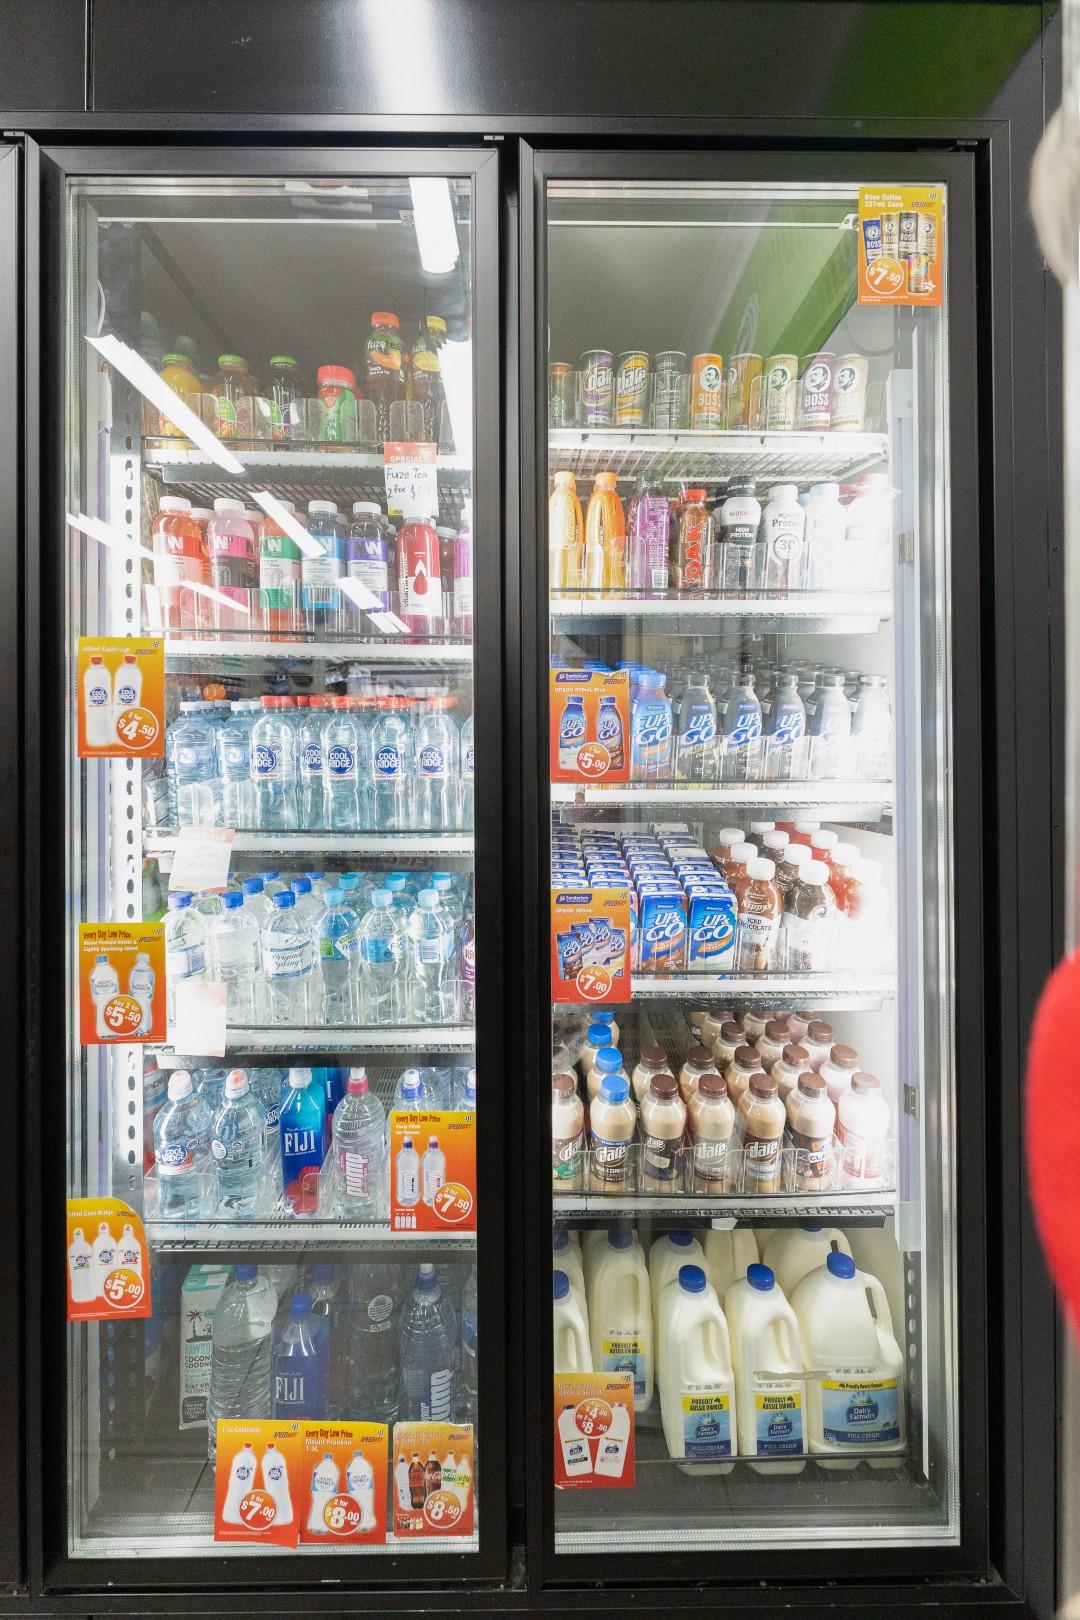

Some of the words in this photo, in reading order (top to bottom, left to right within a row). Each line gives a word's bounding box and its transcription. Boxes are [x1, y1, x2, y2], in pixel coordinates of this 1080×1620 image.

[588, 366, 612, 390] dar
[805, 394, 829, 406] BOSS
[386, 468, 410, 480] Fuze
[684, 514, 703, 578] OAK
[637, 724, 672, 744] GO
[680, 727, 716, 745] GO
[728, 726, 762, 745] GO
[328, 759, 351, 768] RIDGE
[378, 759, 399, 768] RIDGE
[421, 759, 442, 767] RIDGE
[703, 914, 730, 926] UP&
[84, 931, 97, 940] Every
[98, 930, 106, 940] Day
[108, 930, 117, 938] Low
[119, 930, 131, 938] Price
[646, 922, 684, 941] GO
[694, 924, 733, 941] GO
[106, 1006, 140, 1026] $5.50
[396, 1115, 408, 1124] Every
[409, 1114, 418, 1123] Day
[419, 1114, 428, 1122] Low
[284, 1130, 315, 1152] FIJI
[647, 1137, 664, 1148] dare
[750, 1142, 778, 1157] dare
[600, 1146, 626, 1162] dare
[697, 1142, 726, 1158] dare
[346, 1152, 369, 1198] pump
[436, 1193, 469, 1212] $7.50
[105, 1280, 141, 1300] $5.00
[276, 1377, 304, 1400] FIJI
[306, 1430, 319, 1438] Every
[319, 1429, 329, 1438] Day
[330, 1429, 339, 1437] Low
[340, 1430, 353, 1438] Price
[255, 1496, 264, 1504] for
[241, 1500, 276, 1521] $7.00
[326, 1507, 359, 1528] $8.00
[427, 1500, 459, 1520] $8.50
